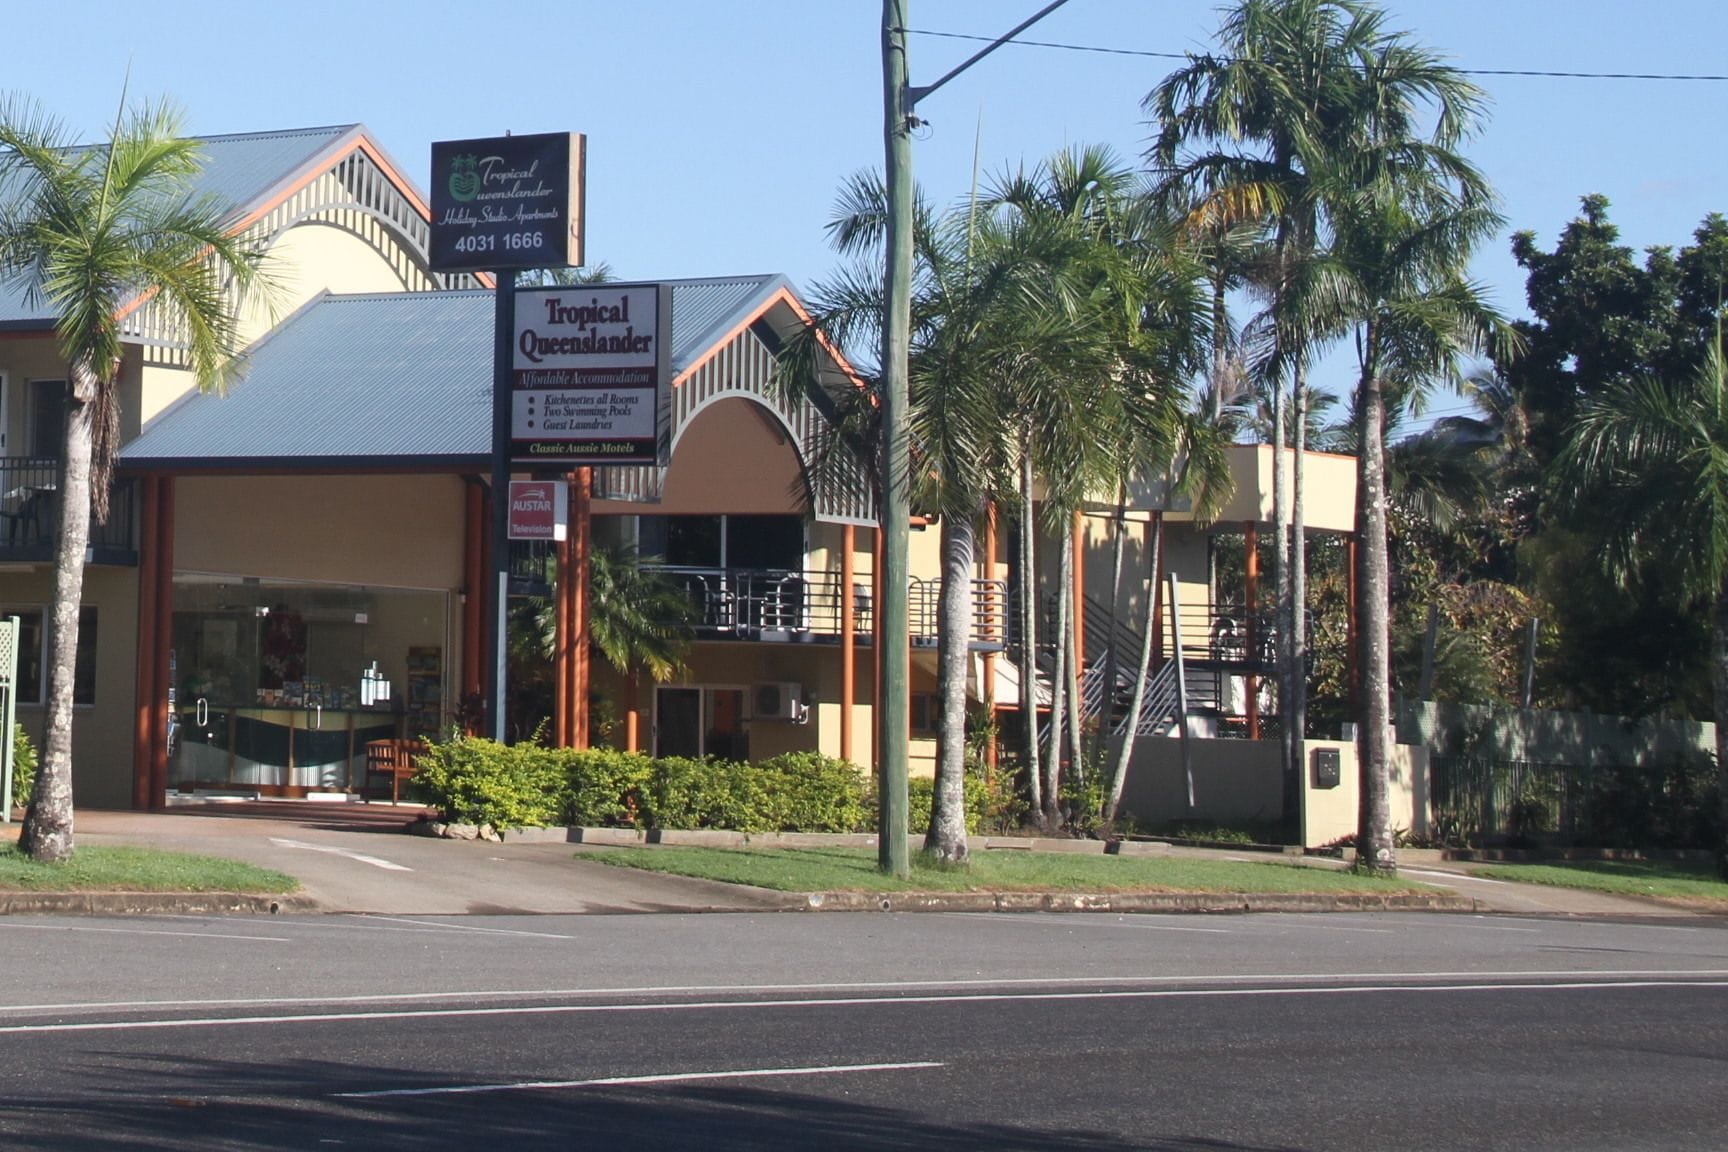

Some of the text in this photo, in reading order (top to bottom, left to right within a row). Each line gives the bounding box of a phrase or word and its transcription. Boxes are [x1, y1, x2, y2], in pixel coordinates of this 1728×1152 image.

[479, 156, 539, 185] Tropical
[438, 203, 559, 228] Holiday Studio Apartments
[455, 231, 543, 252] 4031 1666
[545, 295, 629, 332] Tropical
[519, 326, 652, 363] Queenslander
[519, 369, 650, 388] Affordable Accommodation
[544, 393, 639, 406] Kitchenettes all Rooms
[544, 405, 632, 418] Two Swimming Pools
[543, 418, 612, 431] Guest Laundries
[529, 442, 635, 454] Classic Aussie Motels
[512, 500, 552, 512] AUSTAR
[512, 524, 553, 534] Television
